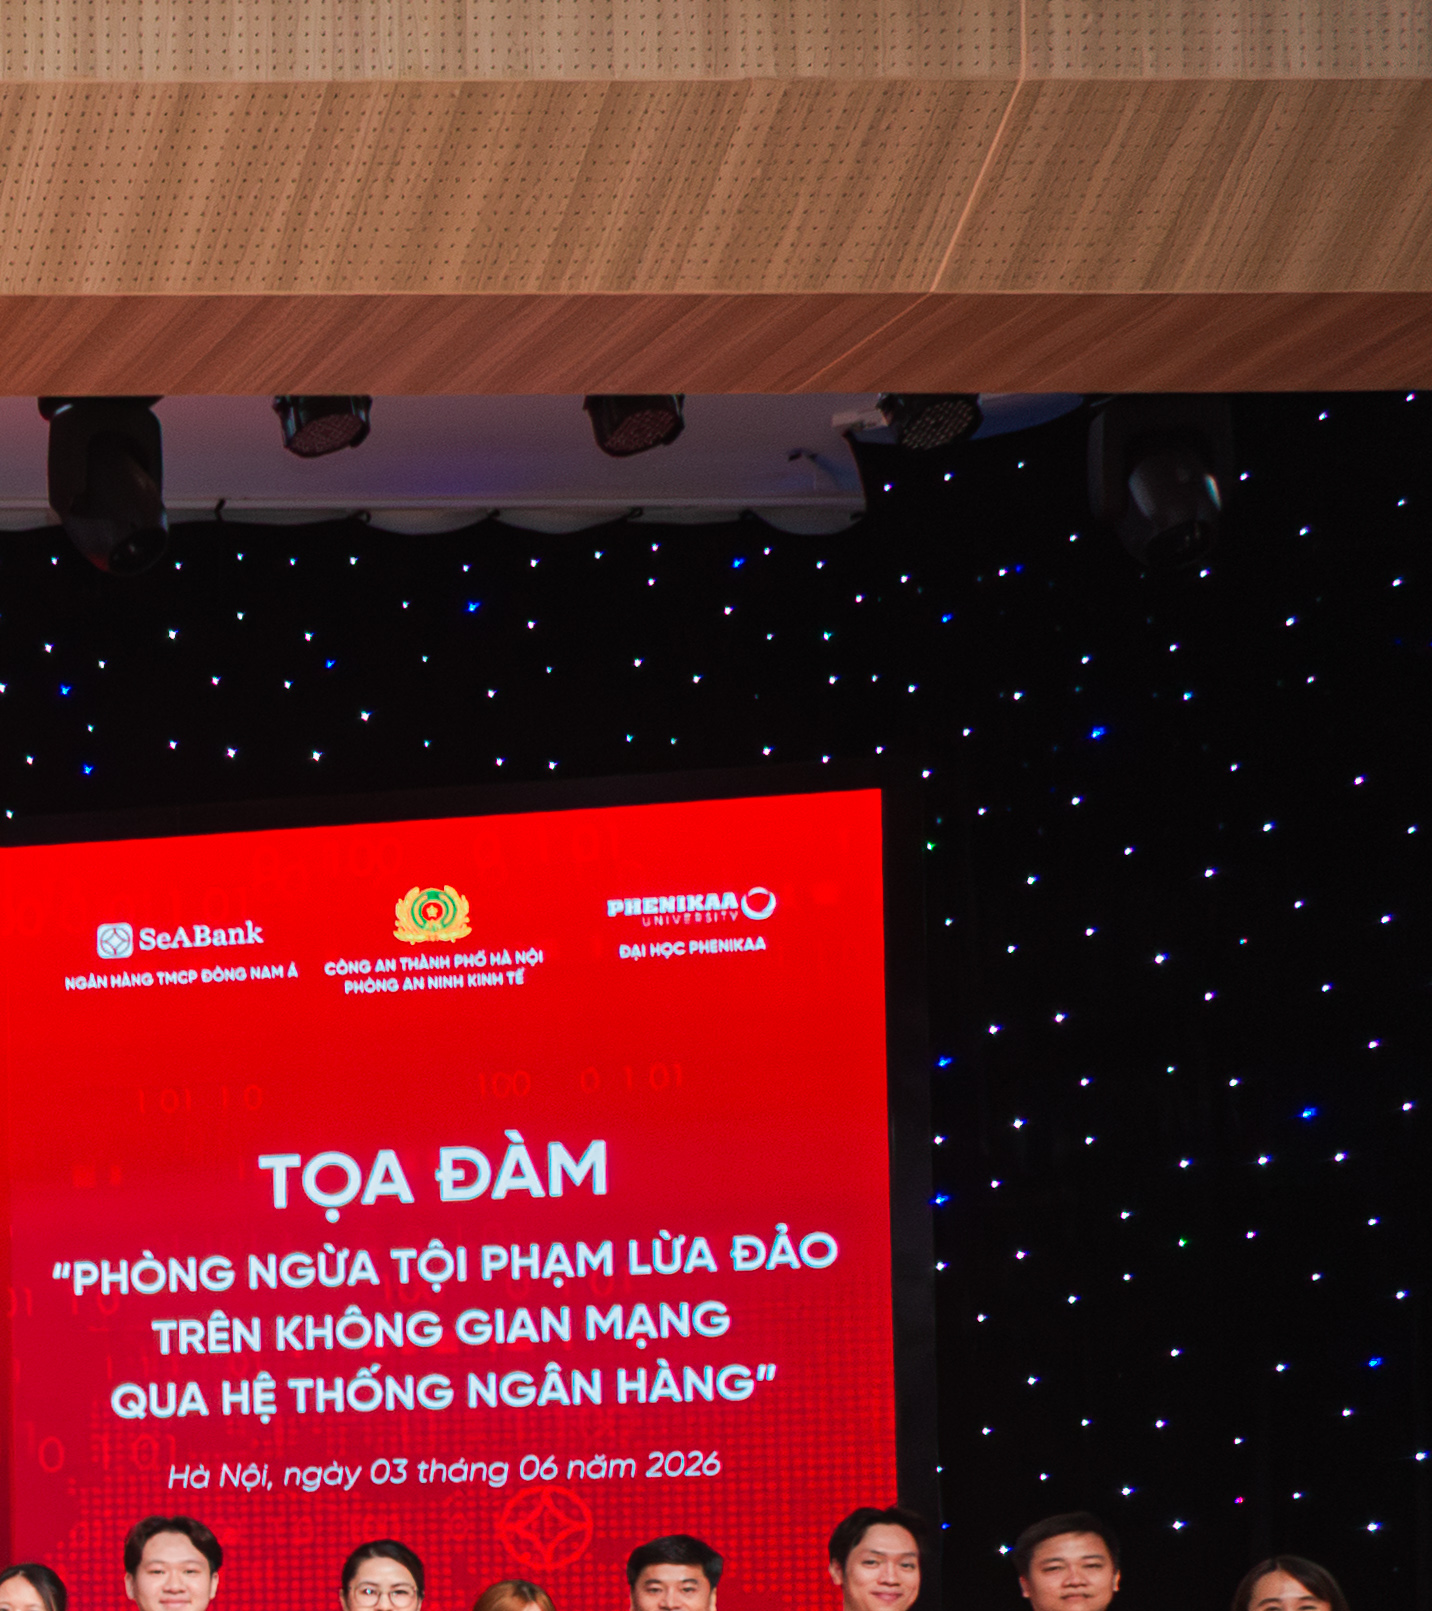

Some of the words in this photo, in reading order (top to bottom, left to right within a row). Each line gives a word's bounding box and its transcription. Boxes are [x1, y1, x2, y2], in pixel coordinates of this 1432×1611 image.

[607, 892, 739, 917] PHENIKAA
[642, 911, 738, 927] UNIVERSITY
[140, 920, 263, 950] SeABank
[620, 944, 646, 961] ĐẠI
[650, 942, 685, 958] HỌC
[689, 937, 766, 954] PHENIKAA
[65, 973, 107, 990] NGÂN
[111, 972, 154, 988] HÀNG
[157, 970, 197, 985] TMCP
[201, 966, 247, 982] ĐÔNG
[250, 965, 283, 979] NAM
[288, 962, 298, 977] Á
[325, 959, 371, 975] CÔNG
[375, 959, 396, 972] AN
[400, 954, 450, 971] THÀNH
[454, 950, 486, 968] PHỐ
[490, 949, 511, 966] HÀ
[515, 948, 543, 966] NỘI
[345, 977, 399, 994] PHÒNG
[403, 977, 424, 991] AN
[428, 975, 463, 989] NINH
[468, 972, 503, 987] KINH
[506, 967, 524, 984] TẾ
[259, 1150, 414, 1223] TỌA
[435, 1130, 606, 1201] ĐÀM
[53, 1250, 235, 1295] “PHÒNG
[249, 1243, 379, 1289] NGỪA
[390, 1239, 466, 1292] TỘI
[482, 1241, 613, 1288] PHẠM
[629, 1230, 717, 1275] LỪA
[730, 1223, 837, 1271] ĐẢO
[152, 1310, 261, 1355] TRÊN
[276, 1305, 442, 1351] KHÔNG
[456, 1306, 570, 1345] GIAN
[586, 1301, 730, 1349] MẠNG
[111, 1382, 209, 1419] QUA
[222, 1371, 276, 1424] HỆ
[288, 1363, 453, 1413] THỐNG
[468, 1362, 601, 1408] NGÂN
[617, 1358, 776, 1403] HÀNG”
[169, 1464, 217, 1488] Hà
[220, 1463, 276, 1492] Nội,
[284, 1461, 362, 1492] ngày
[371, 1459, 407, 1484] 03
[418, 1458, 508, 1487] tháng
[520, 1455, 557, 1480] 06
[568, 1455, 635, 1479] năm
[646, 1451, 720, 1477] 2026
